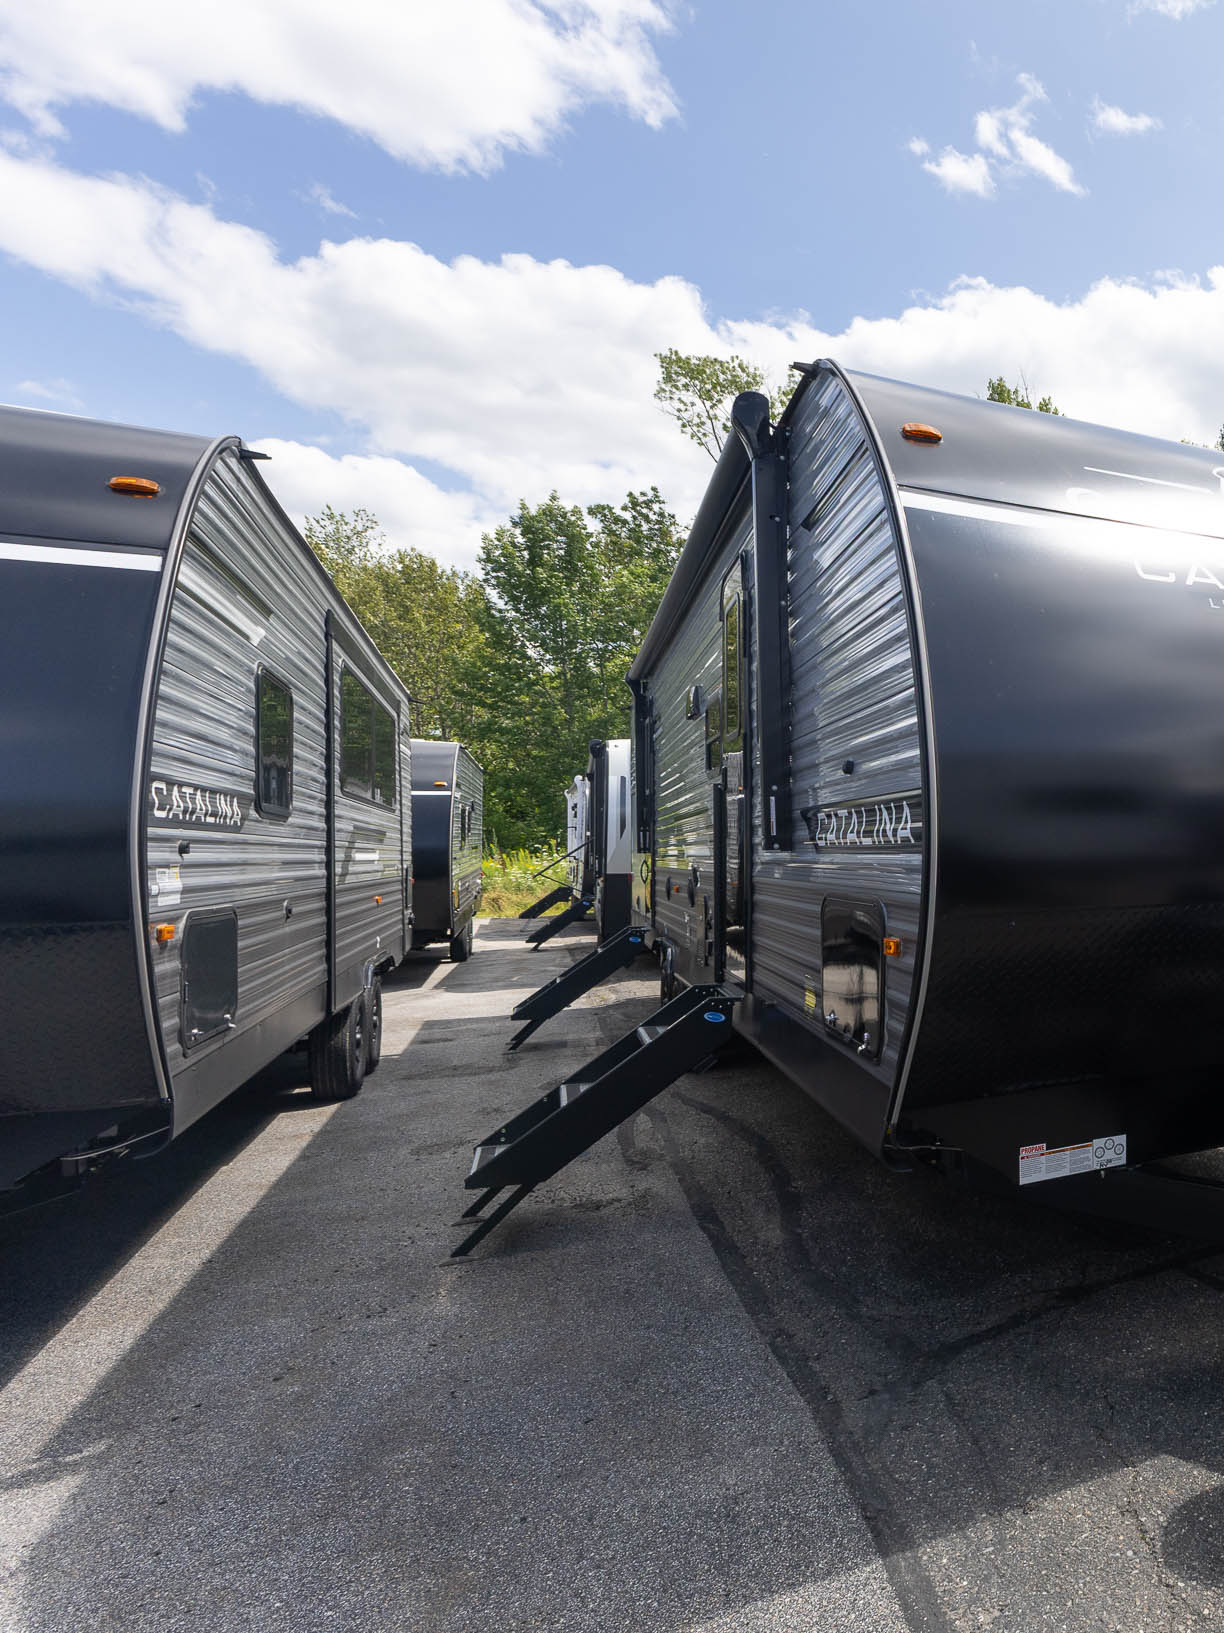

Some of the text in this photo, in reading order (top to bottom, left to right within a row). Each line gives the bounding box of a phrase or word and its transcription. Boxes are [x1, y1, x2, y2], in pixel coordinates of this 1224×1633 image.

[152, 780, 241, 826] CATALINA
[815, 800, 915, 846] CATALINA
[1020, 1144, 1045, 1155] PROPANE
